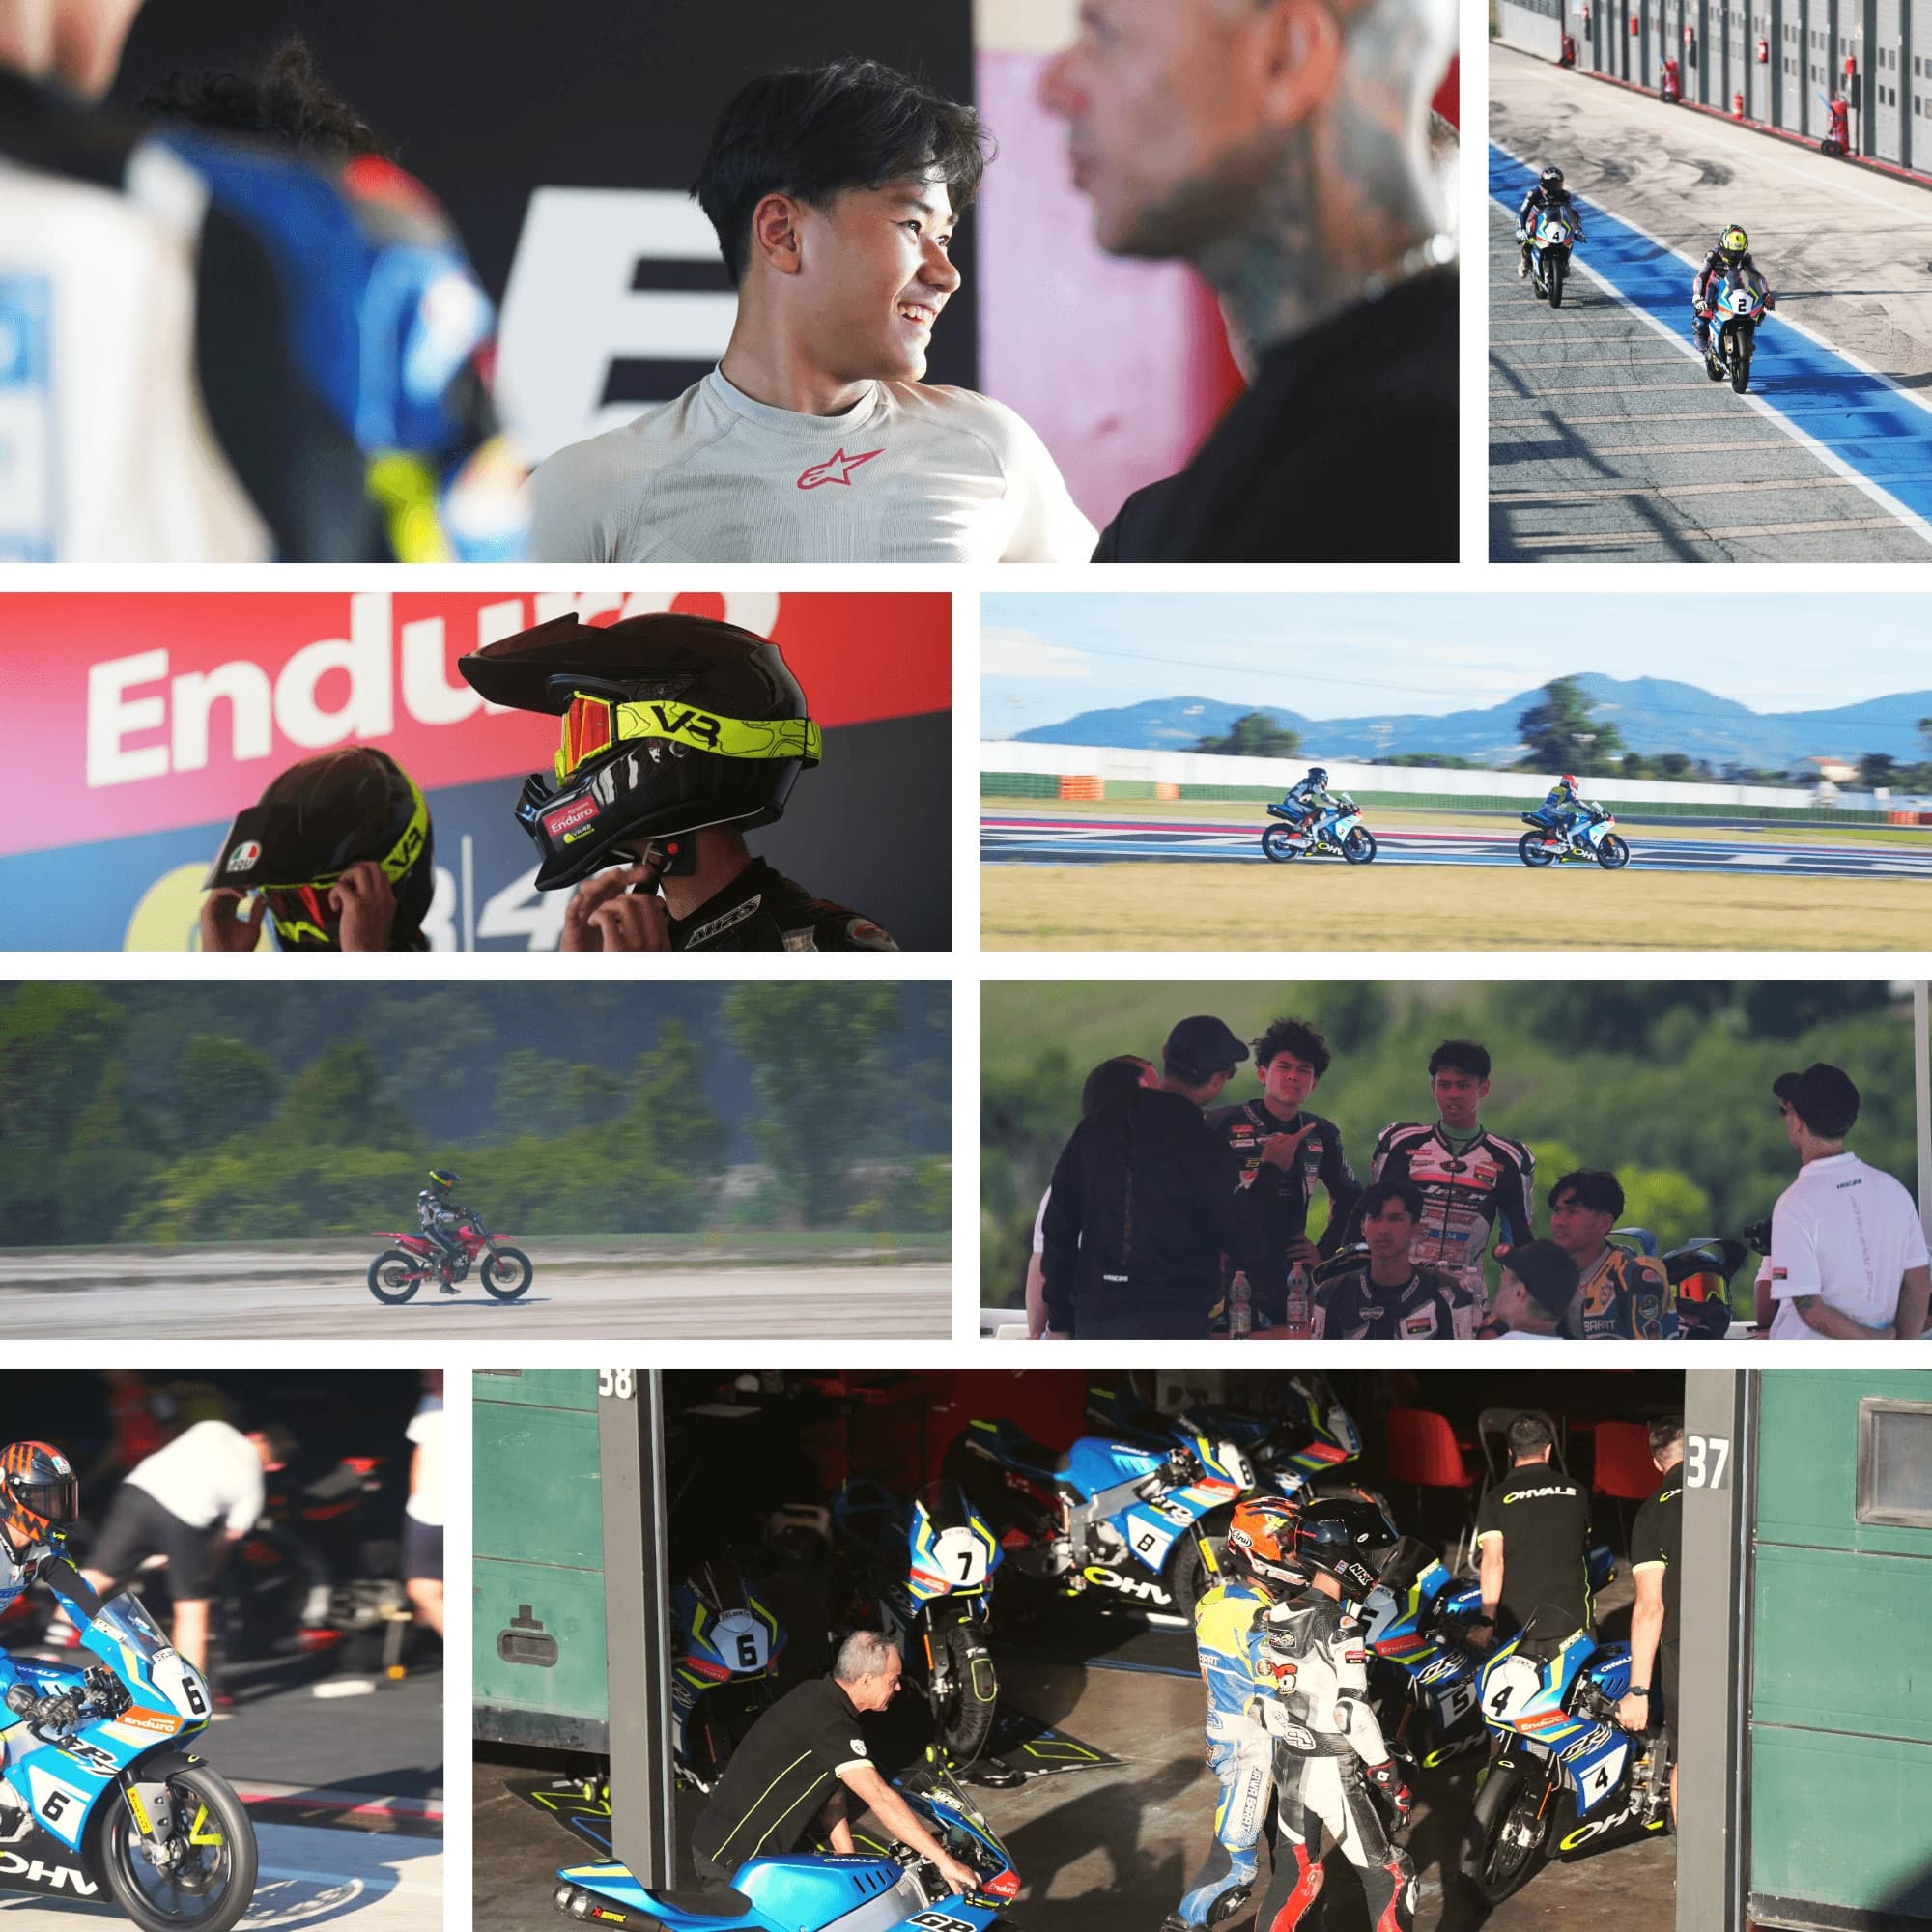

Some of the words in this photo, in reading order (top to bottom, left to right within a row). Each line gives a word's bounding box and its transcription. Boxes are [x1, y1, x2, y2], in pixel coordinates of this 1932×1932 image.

[1738, 298, 1747, 312] 2
[551, 808, 593, 833] Enduro
[1687, 1435, 1729, 1489] 37
[1502, 1486, 1577, 1504] OHVALE
[1137, 1533, 1156, 1552] 8
[1232, 1530, 1251, 1546] Arai
[957, 1551, 973, 1581] 7
[1350, 1562, 1373, 1586] NHK
[736, 1634, 758, 1668] 6
[181, 1676, 207, 1715] 6
[1452, 1686, 1470, 1717] 5
[1490, 1685, 1514, 1718] 4
[124, 1717, 175, 1732] Enduro
[1520, 1717, 1565, 1731] Enduro
[1247, 1765, 1263, 1798] JAWA
[1594, 1766, 1609, 1789] 4
[42, 1790, 71, 1822] 6
[1241, 1797, 1258, 1833] BARAT
[988, 1883, 1016, 1894] Enduro
